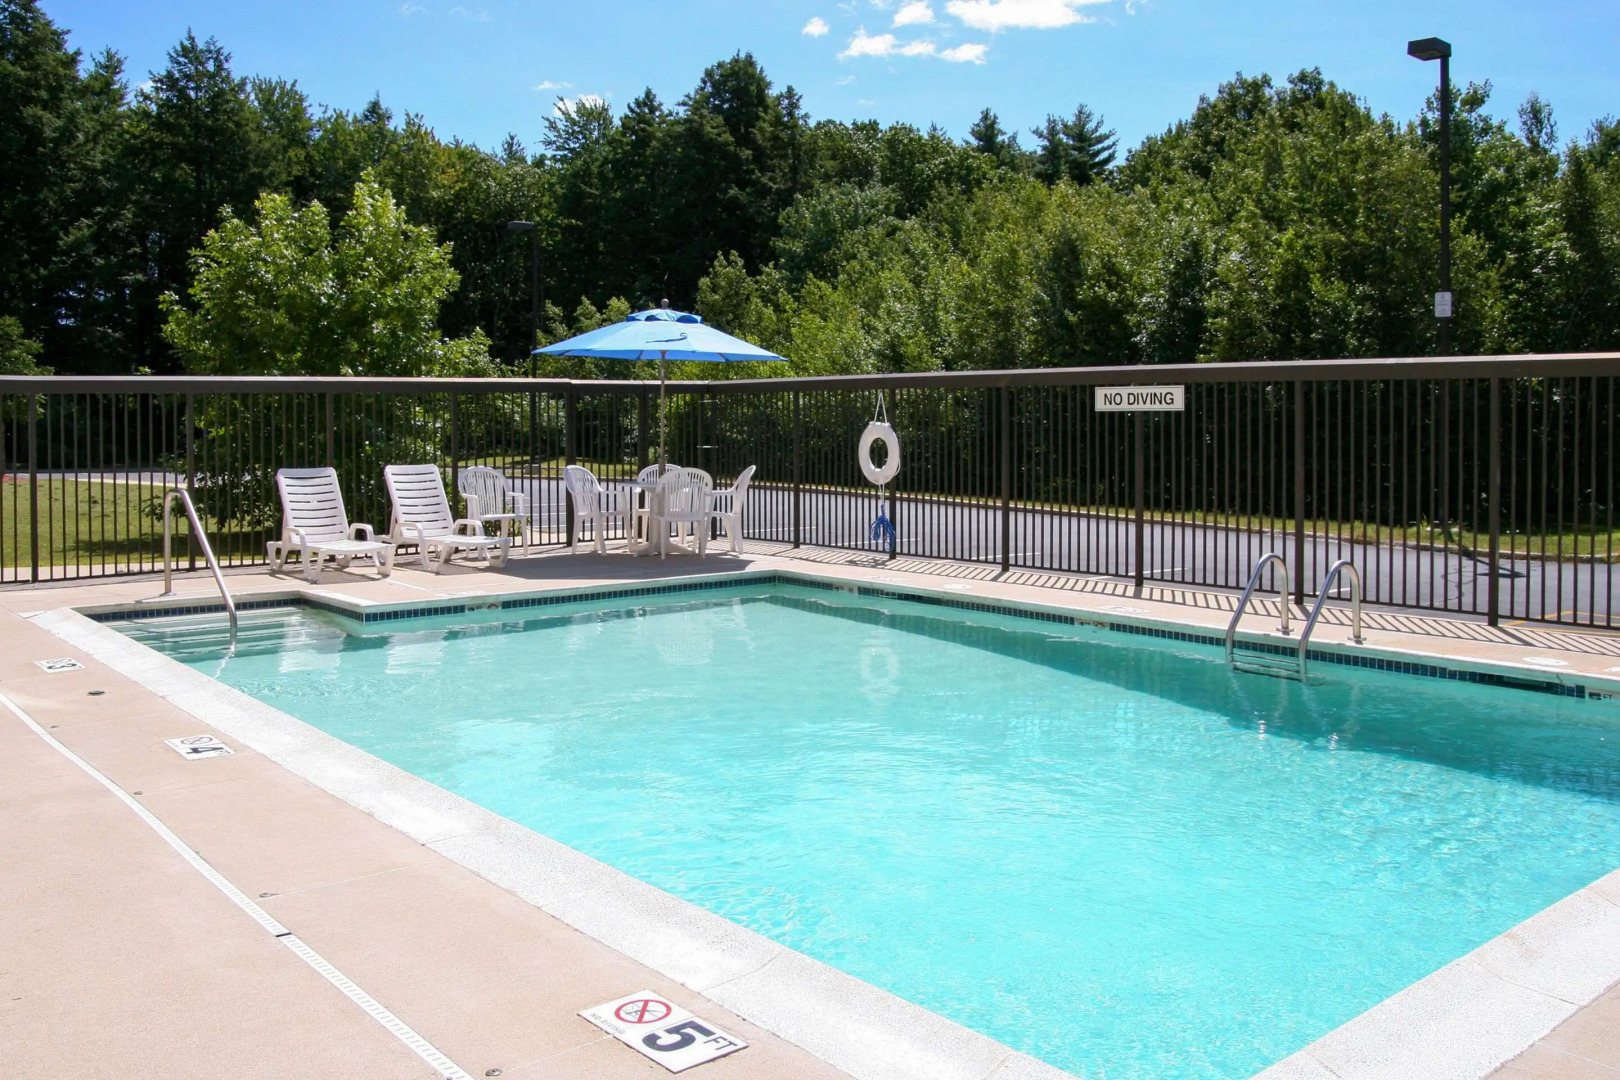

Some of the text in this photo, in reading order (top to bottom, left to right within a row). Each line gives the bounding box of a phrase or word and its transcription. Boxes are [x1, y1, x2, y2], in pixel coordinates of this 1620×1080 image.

[1104, 392, 1175, 406] NO DIVING
[590, 1012, 626, 1035] NO DIVING
[642, 1020, 738, 1052] 5 FT
